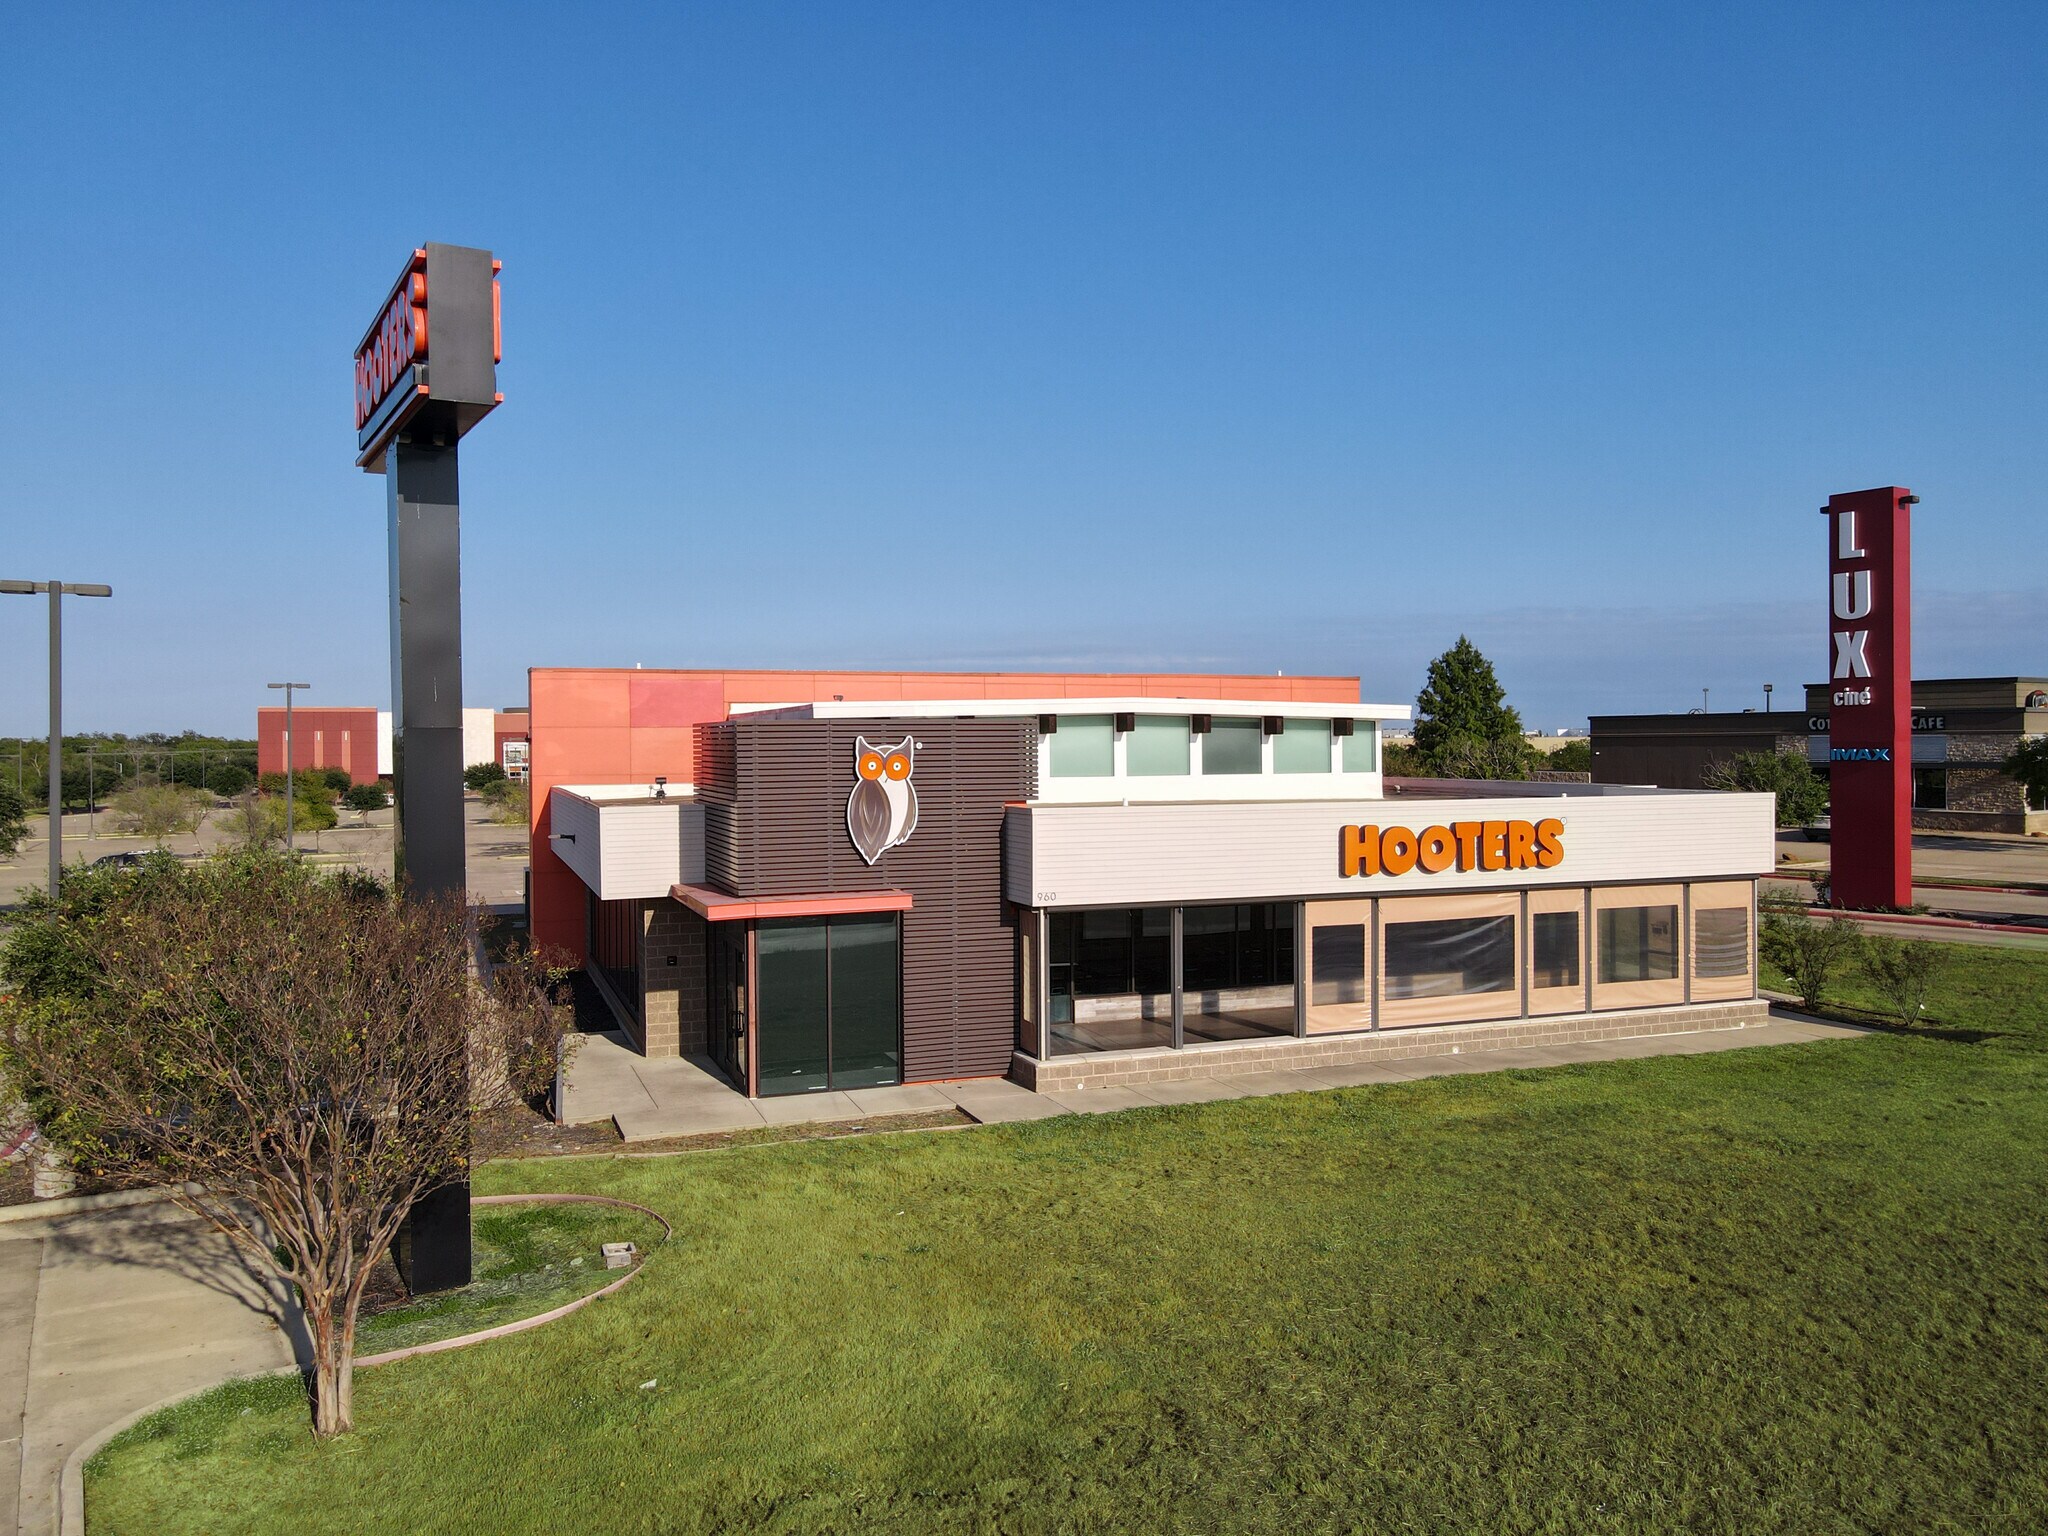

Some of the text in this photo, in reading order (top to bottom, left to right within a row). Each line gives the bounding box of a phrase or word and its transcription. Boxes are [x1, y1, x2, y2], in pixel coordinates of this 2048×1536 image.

[355, 271, 426, 431] HOOTERS
[1833, 511, 1872, 679] LUX
[1833, 686, 1871, 706] ciné
[1910, 716, 1945, 730] CAFE
[1830, 748, 1890, 761] IMAX
[1338, 818, 1565, 878] HOOTERS
[1037, 892, 1057, 901] 960
